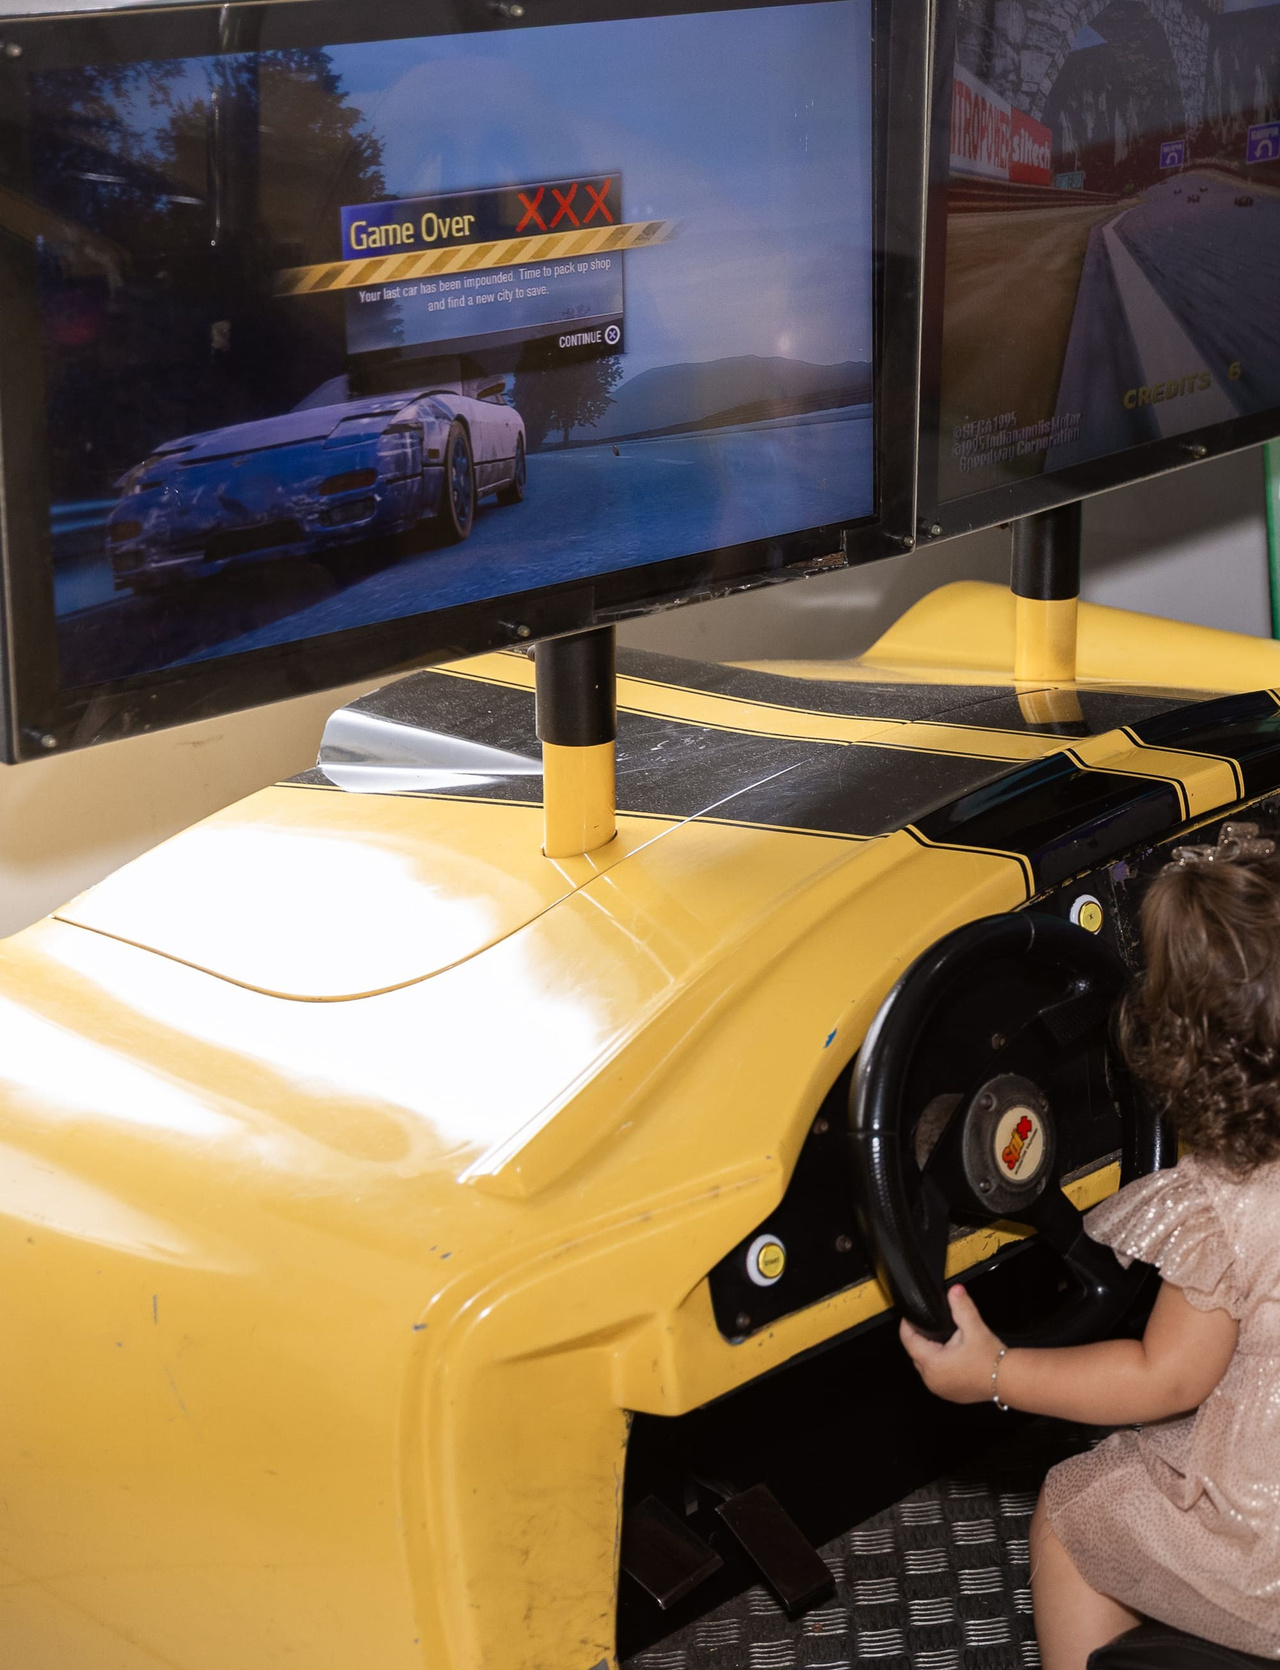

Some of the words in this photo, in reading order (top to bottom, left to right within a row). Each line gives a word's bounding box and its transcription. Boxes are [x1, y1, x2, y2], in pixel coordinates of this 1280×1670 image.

[350, 220, 415, 250] Game
[421, 212, 476, 242] Over
[359, 290, 382, 304] Your
[383, 286, 401, 300] last
[402, 285, 419, 297] car
[420, 282, 437, 295] has
[439, 280, 461, 292] been
[463, 270, 516, 289] impounded.
[518, 267, 541, 281] Time
[543, 265, 552, 278] to
[554, 262, 576, 278] pack
[577, 261, 589, 274] up
[590, 258, 612, 271] shop
[427, 298, 445, 312] and
[447, 295, 466, 309] find
[467, 296, 474, 306] a
[476, 292, 495, 305] new
[497, 288, 514, 303] city
[515, 287, 525, 299] to
[526, 285, 550, 298] save.
[559, 330, 602, 348] CONTINUE
[1122, 372, 1211, 410] CREDITS
[1227, 361, 1242, 382] 6
[960, 444, 1015, 473] Speedway
[1016, 427, 1081, 456] Corporation
[986, 419, 1050, 450] Indianapolis
[1051, 412, 1082, 432] Motor
